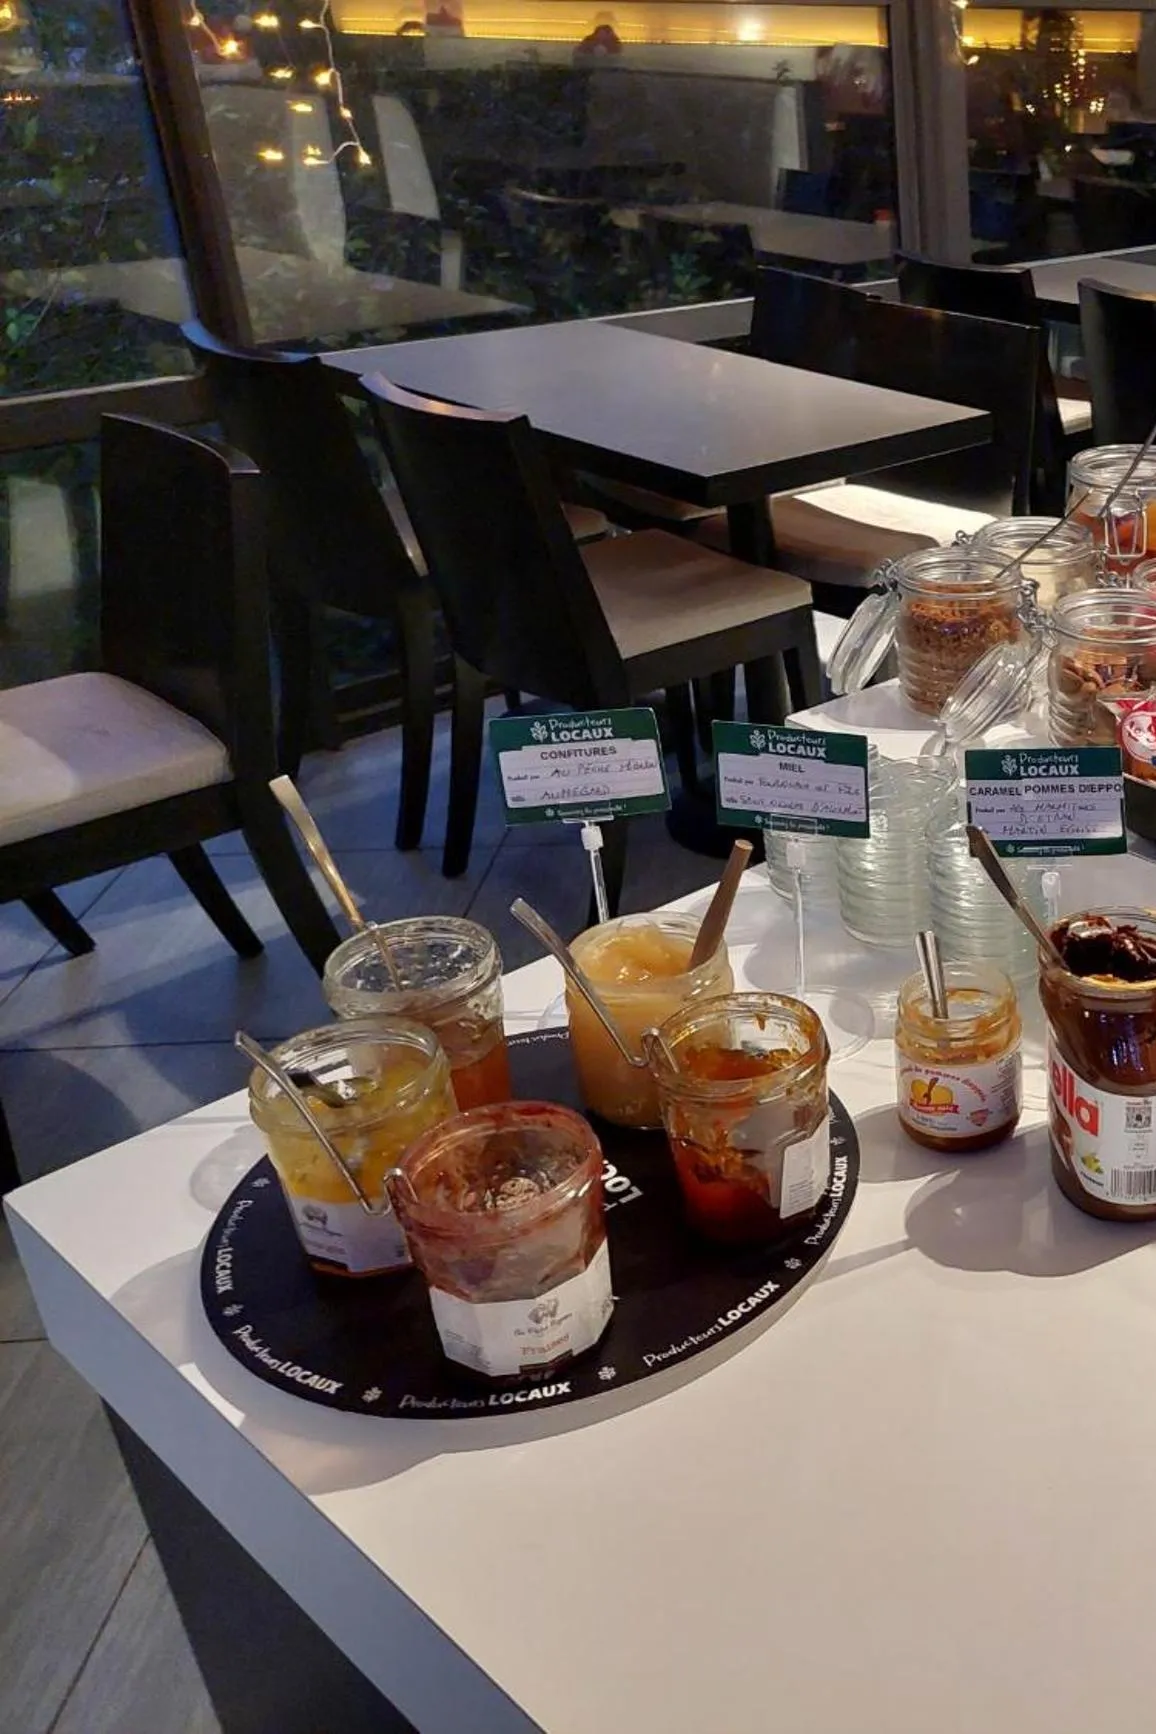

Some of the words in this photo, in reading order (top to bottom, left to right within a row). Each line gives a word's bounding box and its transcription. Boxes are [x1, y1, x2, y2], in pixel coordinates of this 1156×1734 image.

[548, 716, 612, 731] Producteurs
[551, 727, 615, 742] LOCAUX
[767, 729, 826, 746] Producteurs
[540, 746, 617, 761] CONFITURES
[768, 742, 827, 758] LOCAUX
[779, 761, 806, 773] MIEL
[1020, 764, 1080, 777] LOCAUX
[969, 786, 1022, 797] CARAMEL
[1024, 783, 1075, 794] POMMES
[1078, 783, 1122, 793] DIEPPO
[1052, 1060, 1099, 1137] ella
[601, 1159, 643, 1204] LOC
[830, 1155, 848, 1198] LOCAUX
[215, 1247, 233, 1294] LOCAUX
[643, 1323, 723, 1366] Producteurs
[718, 1280, 780, 1327] LOCAUX
[278, 1361, 343, 1394] LOCAUX
[488, 1381, 572, 1406] LOCAUX
